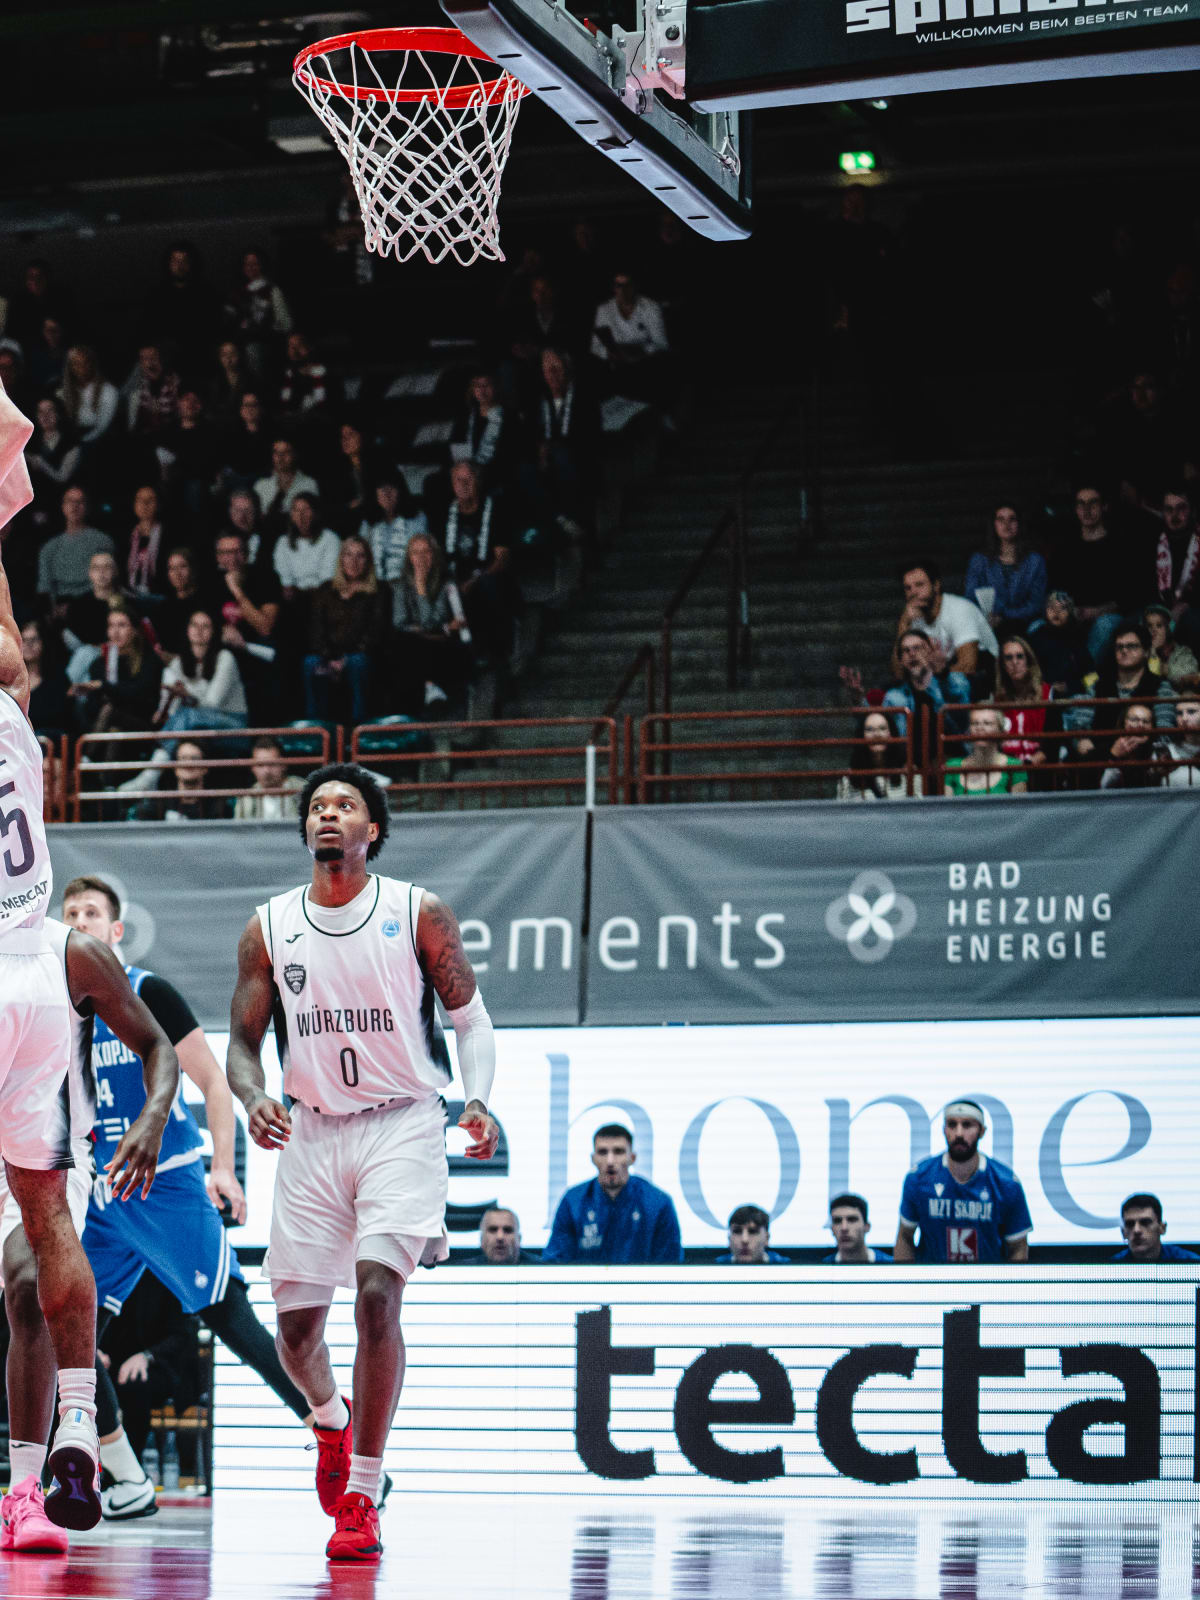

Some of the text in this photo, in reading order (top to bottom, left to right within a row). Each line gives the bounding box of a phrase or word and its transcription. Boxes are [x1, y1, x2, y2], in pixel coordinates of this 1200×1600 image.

[916, 4, 1189, 44] WILLKOMMEN BEIM BESTEN TEAM
[949, 861, 1021, 890] BAD
[1, 880, 48, 911] MERCAT
[947, 893, 1112, 926] HEIZUNG
[459, 902, 786, 973] ements
[946, 931, 1107, 963] ENERGIE
[296, 1004, 394, 1037] WÜRZBURG
[92, 1039, 136, 1068] KOPJE
[339, 1047, 359, 1088] 0
[542, 1054, 1152, 1232] home
[950, 1229, 973, 1254] K
[574, 1286, 1200, 1486] tecta
